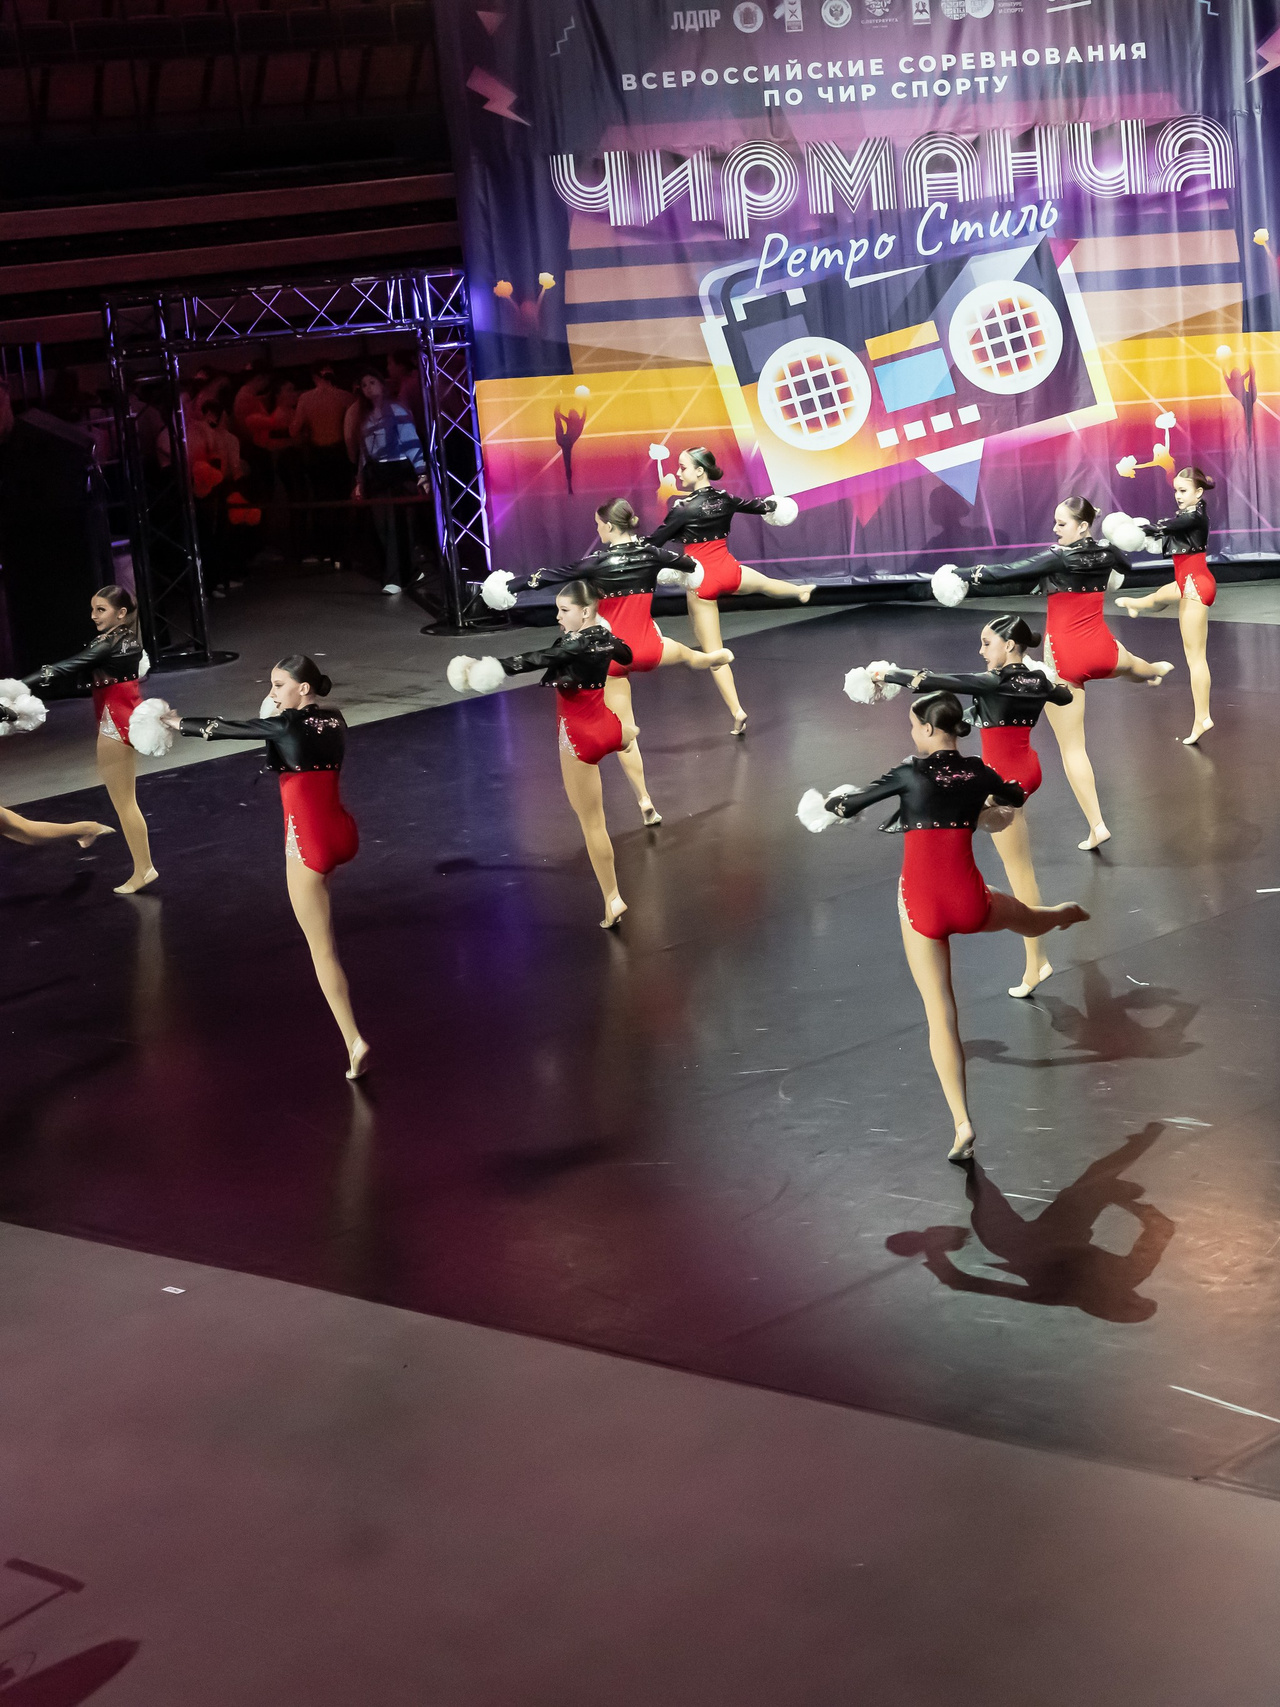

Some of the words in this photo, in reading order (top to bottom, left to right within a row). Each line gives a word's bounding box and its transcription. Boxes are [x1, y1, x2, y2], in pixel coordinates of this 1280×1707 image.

[670, 9, 721, 32] ЛДПР
[622, 58, 885, 91] ВСЕРОССИЙСКИЕ
[898, 42, 1147, 74] СОРЕВНОВАНИЯ
[763, 88, 803, 107] ПО
[817, 84, 877, 104] ЧИР
[891, 75, 1009, 99] СПОРТУ
[755, 232, 896, 289] Ретро
[916, 200, 1059, 256] Стиль
